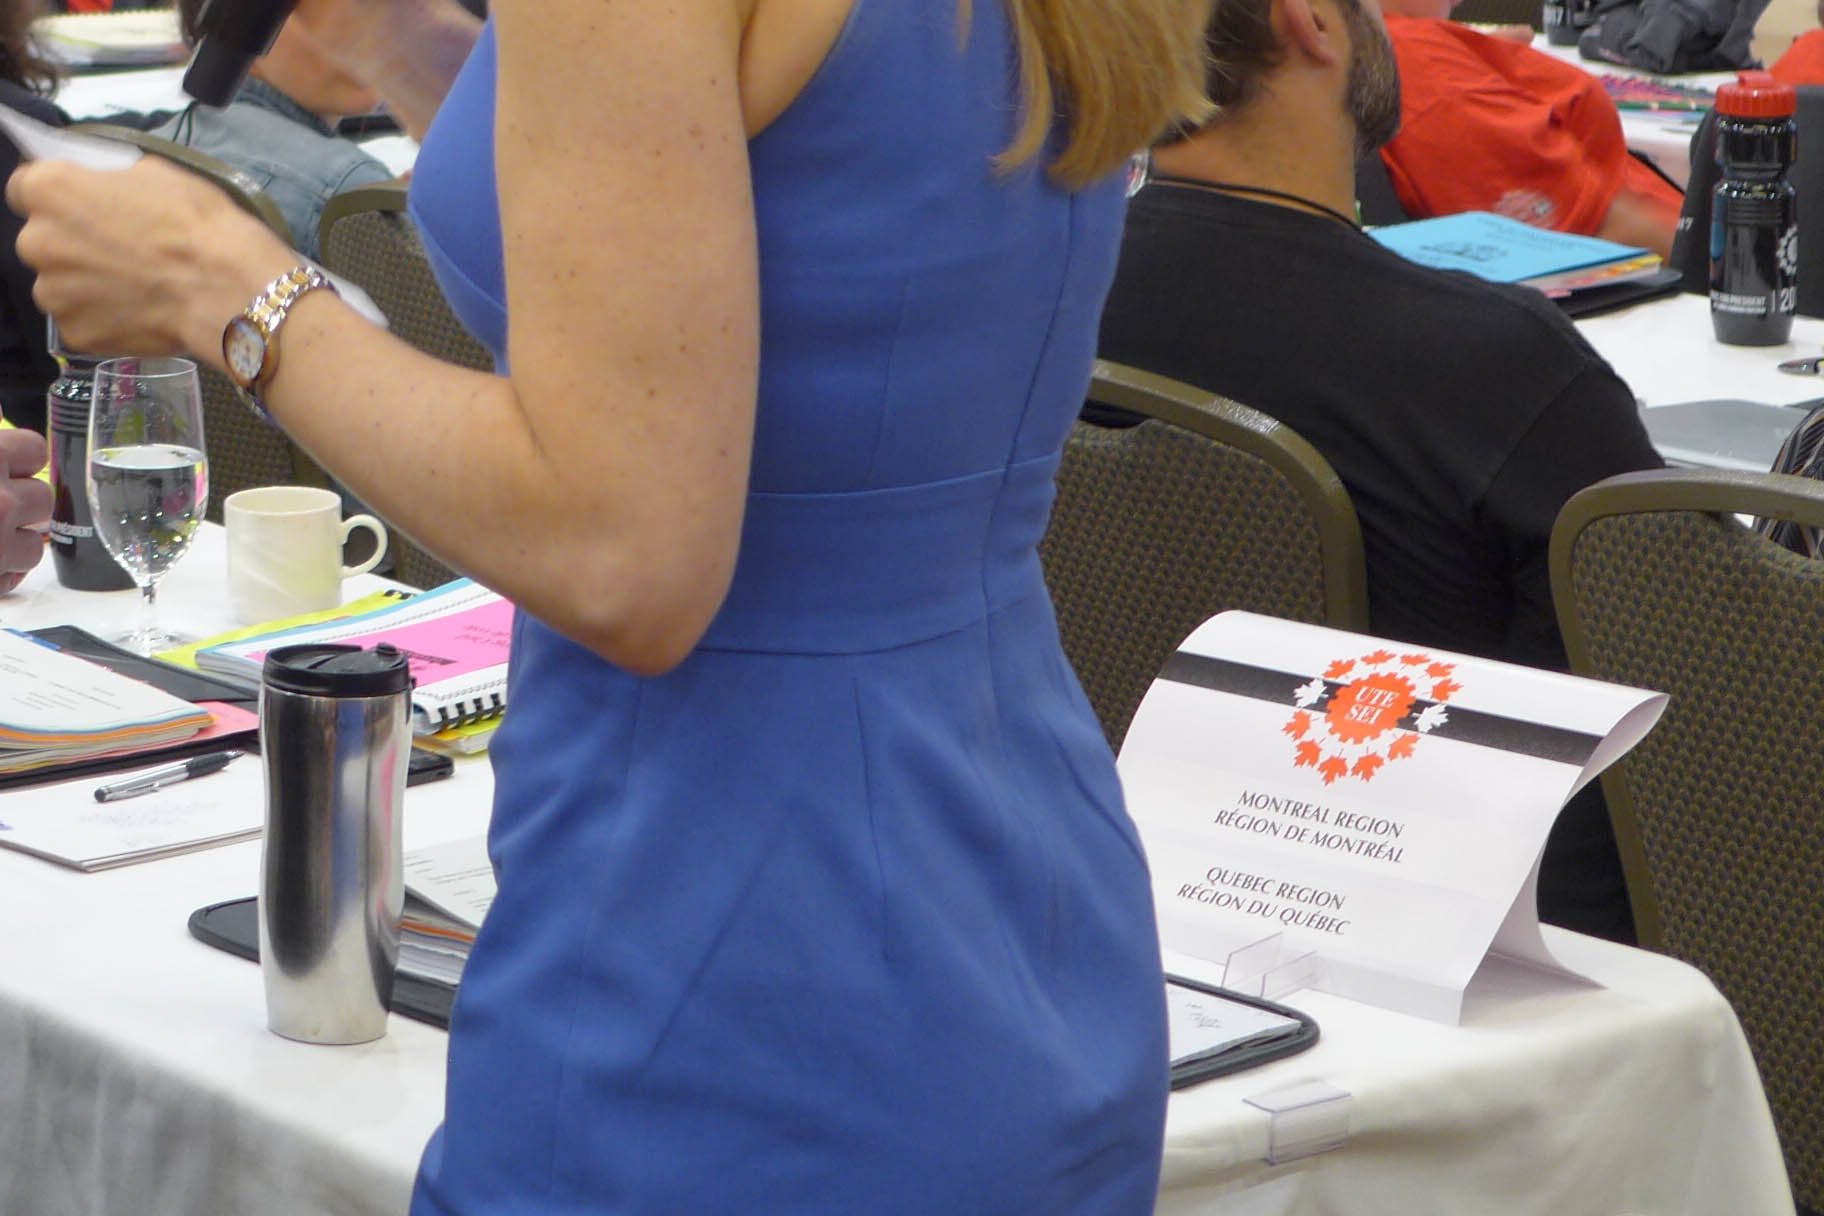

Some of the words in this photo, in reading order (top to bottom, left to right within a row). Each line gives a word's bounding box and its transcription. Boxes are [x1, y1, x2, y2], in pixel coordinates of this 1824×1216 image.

[1343, 703, 1384, 725] SEI
[1355, 685, 1400, 709] UTE
[1214, 809, 1283, 837] RÉGION
[1283, 825, 1310, 843] DE
[1310, 831, 1404, 863] MONTRÉAL
[1238, 790, 1330, 824] MONTREAL
[1334, 810, 1405, 839] REGION
[1177, 882, 1247, 911] RÉGION
[1247, 899, 1277, 918] DU
[1279, 910, 1351, 935] QUÉBEC
[1206, 867, 1276, 895] QUEBEC
[1276, 882, 1346, 911] REGION
